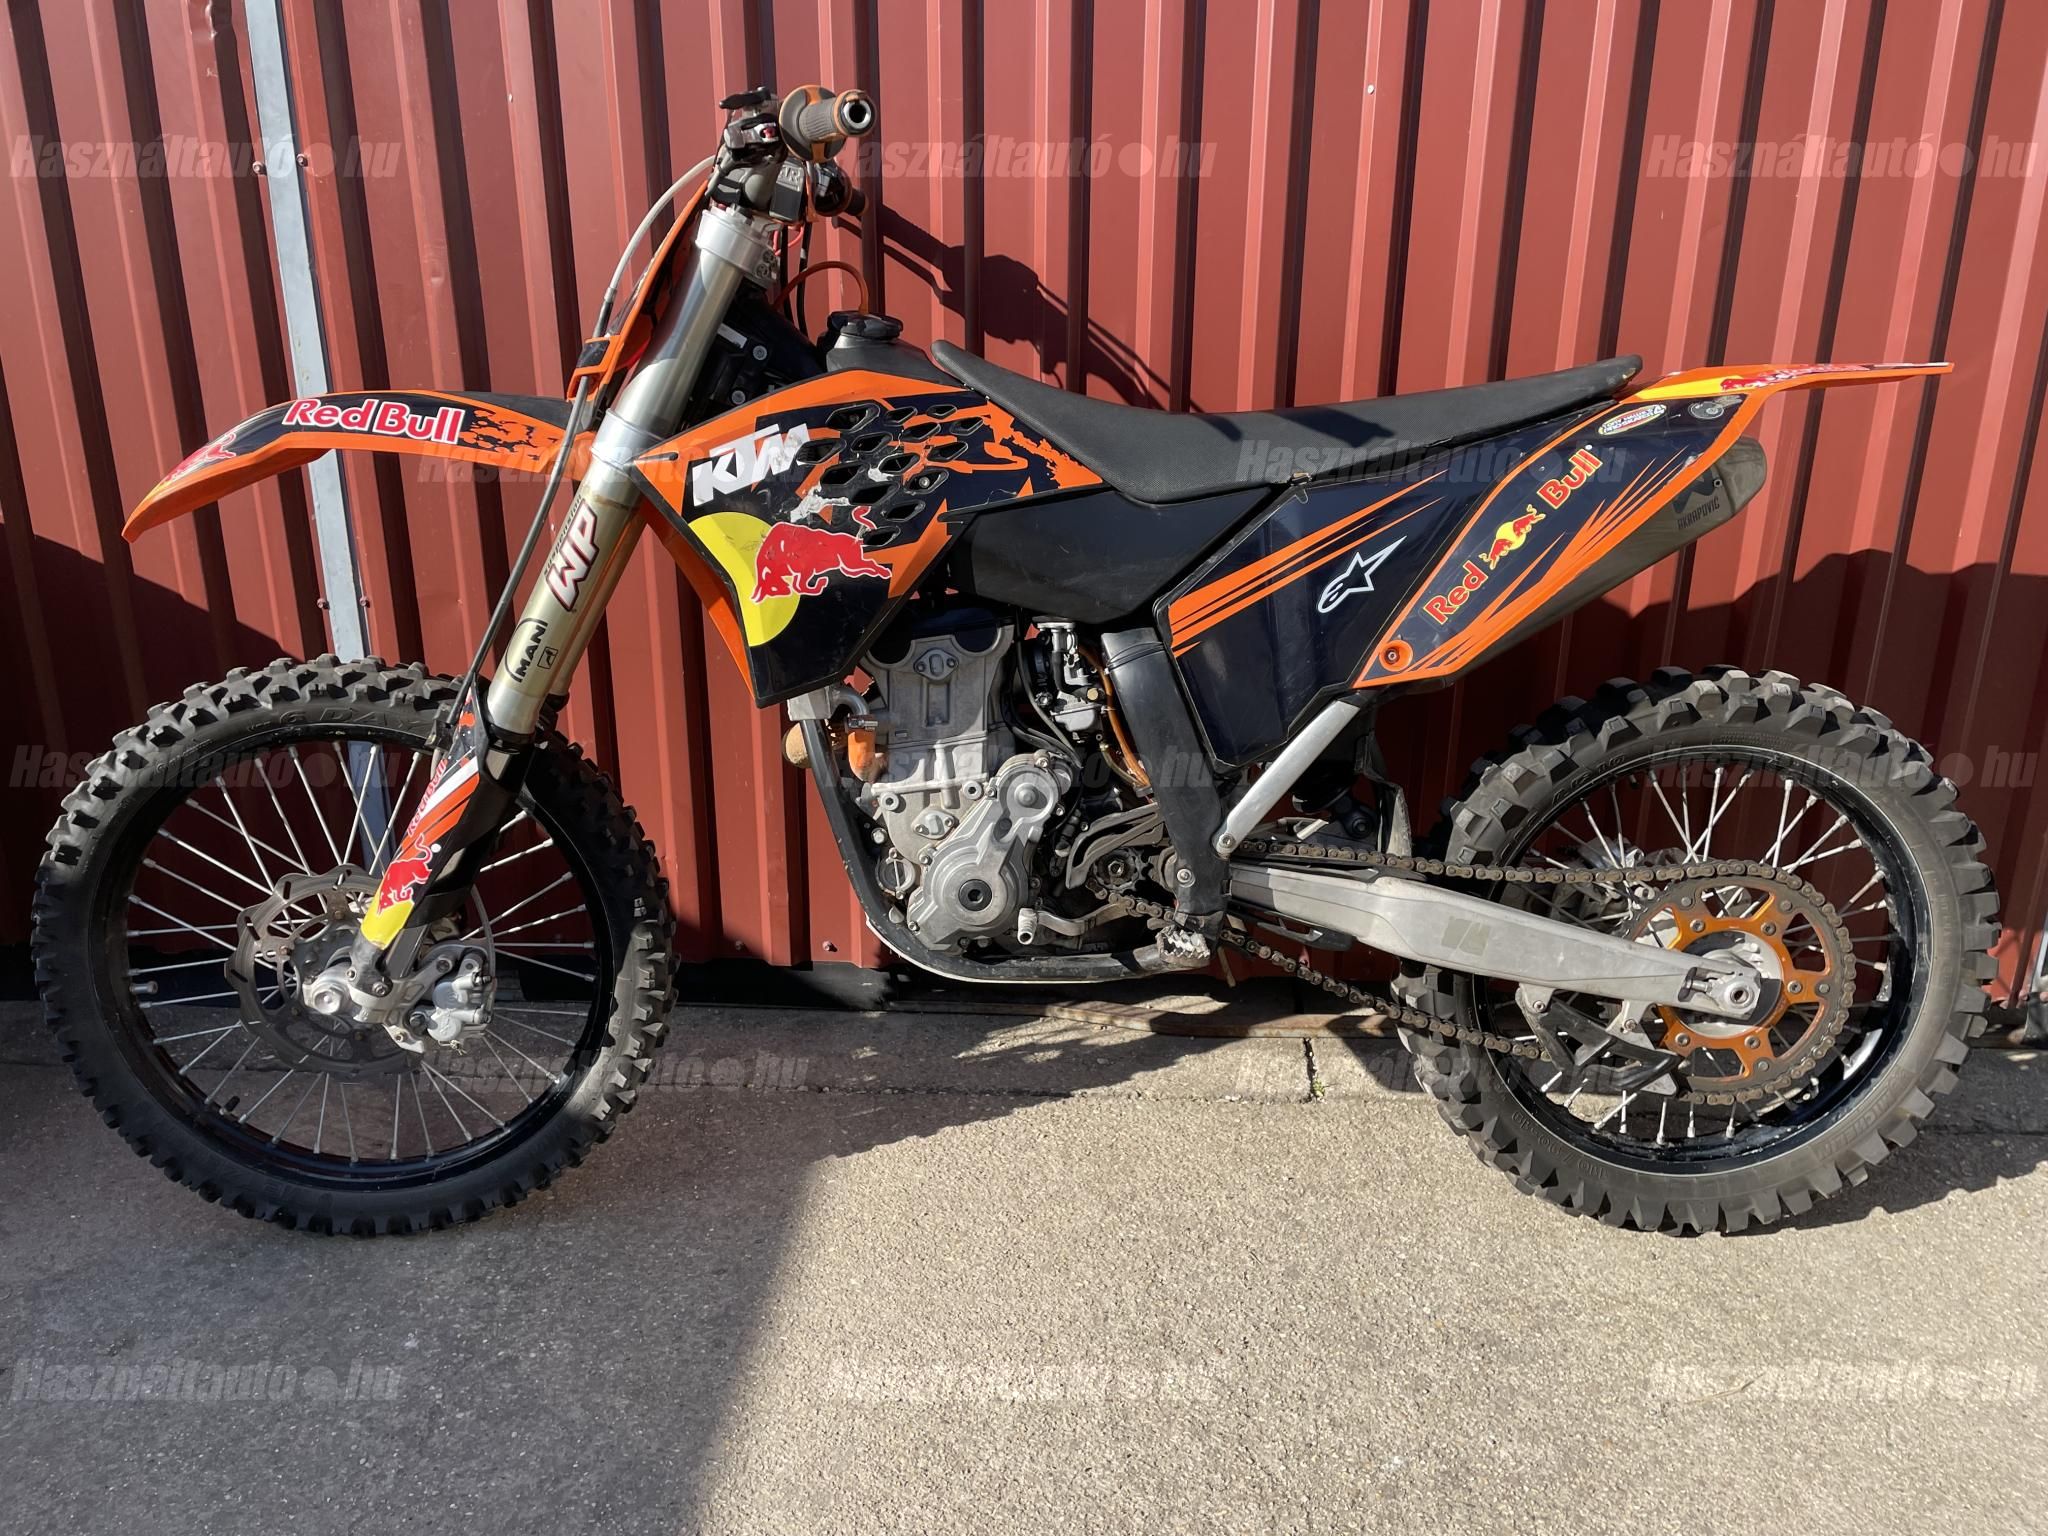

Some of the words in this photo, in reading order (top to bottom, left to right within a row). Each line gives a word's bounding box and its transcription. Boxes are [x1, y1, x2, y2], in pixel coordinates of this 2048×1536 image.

[282, 399, 379, 431] Red
[372, 402, 466, 445] Bull
[692, 423, 810, 507] KTM
[546, 499, 600, 612] WP
[1423, 560, 1488, 625] Red
[1537, 449, 1603, 509] Bull
[515, 623, 548, 679] MAN
